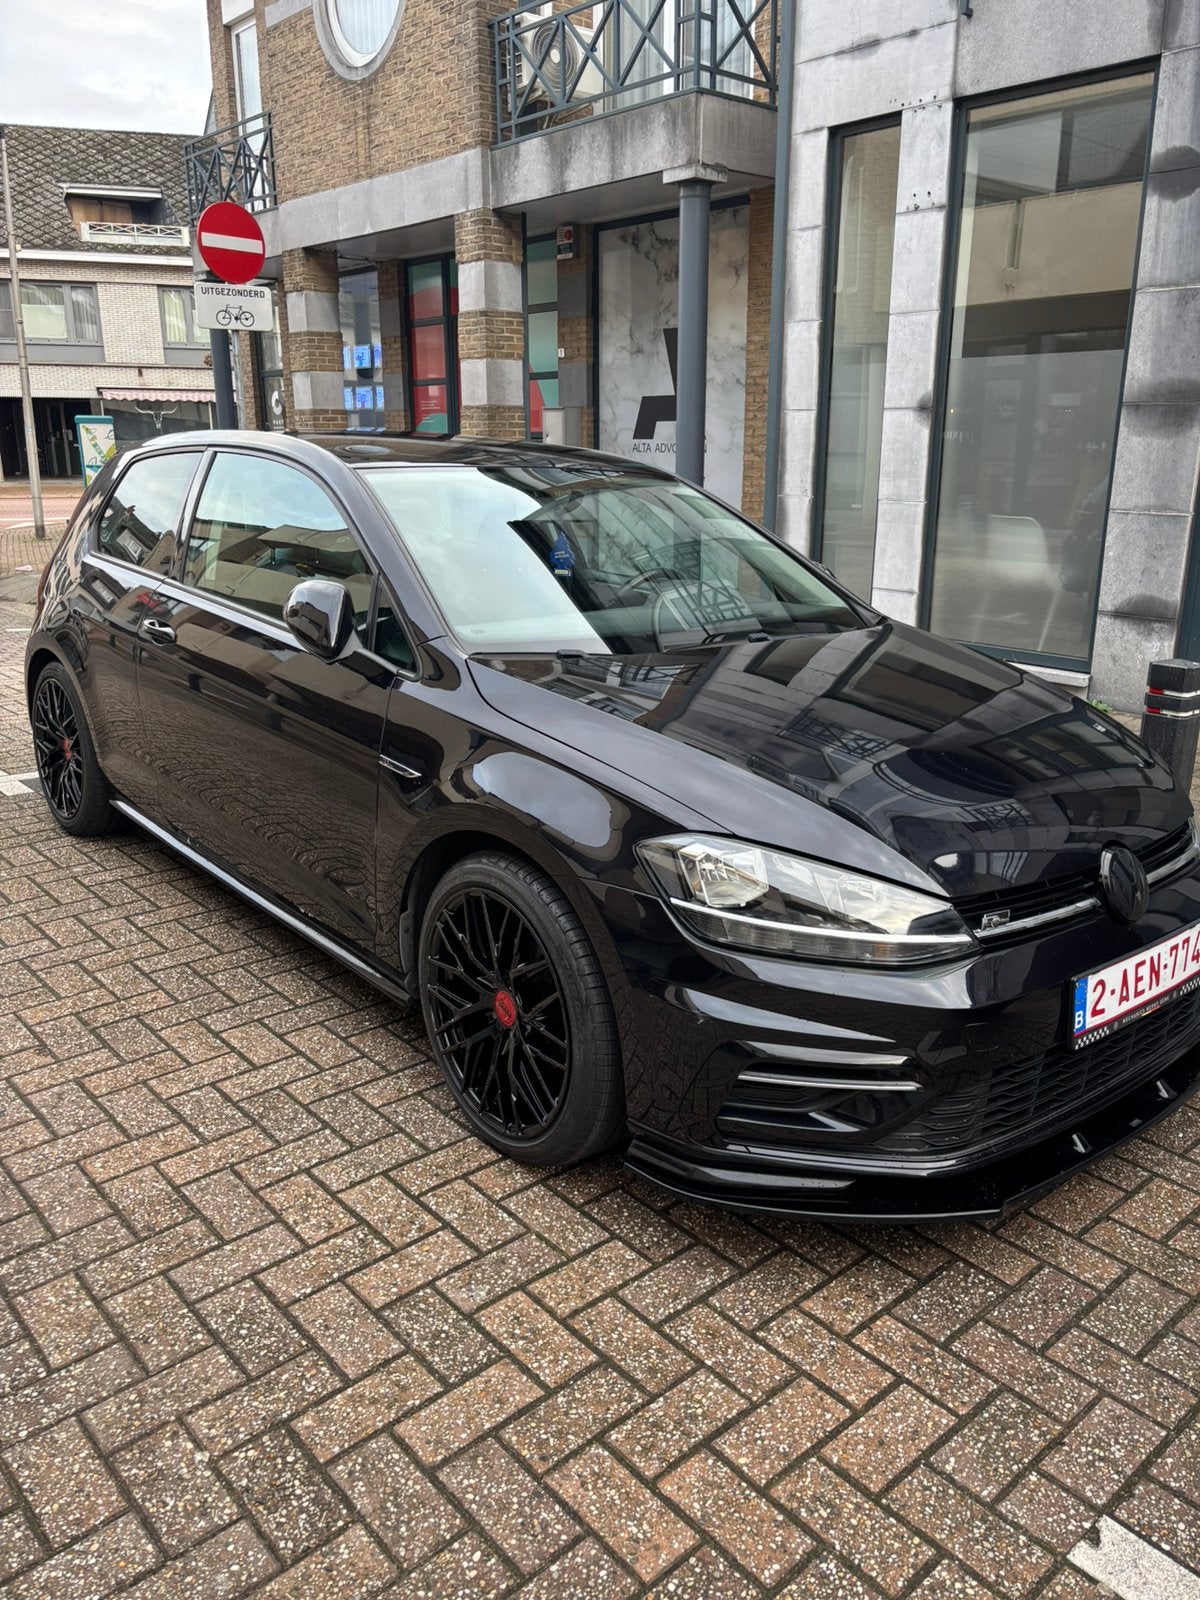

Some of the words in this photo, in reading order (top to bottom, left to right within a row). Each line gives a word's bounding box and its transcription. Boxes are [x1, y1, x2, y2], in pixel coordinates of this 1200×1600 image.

[201, 287, 265, 298] UITGEZONDERD
[632, 443, 652, 453] ALTA
[1075, 1010, 1084, 1030] B
